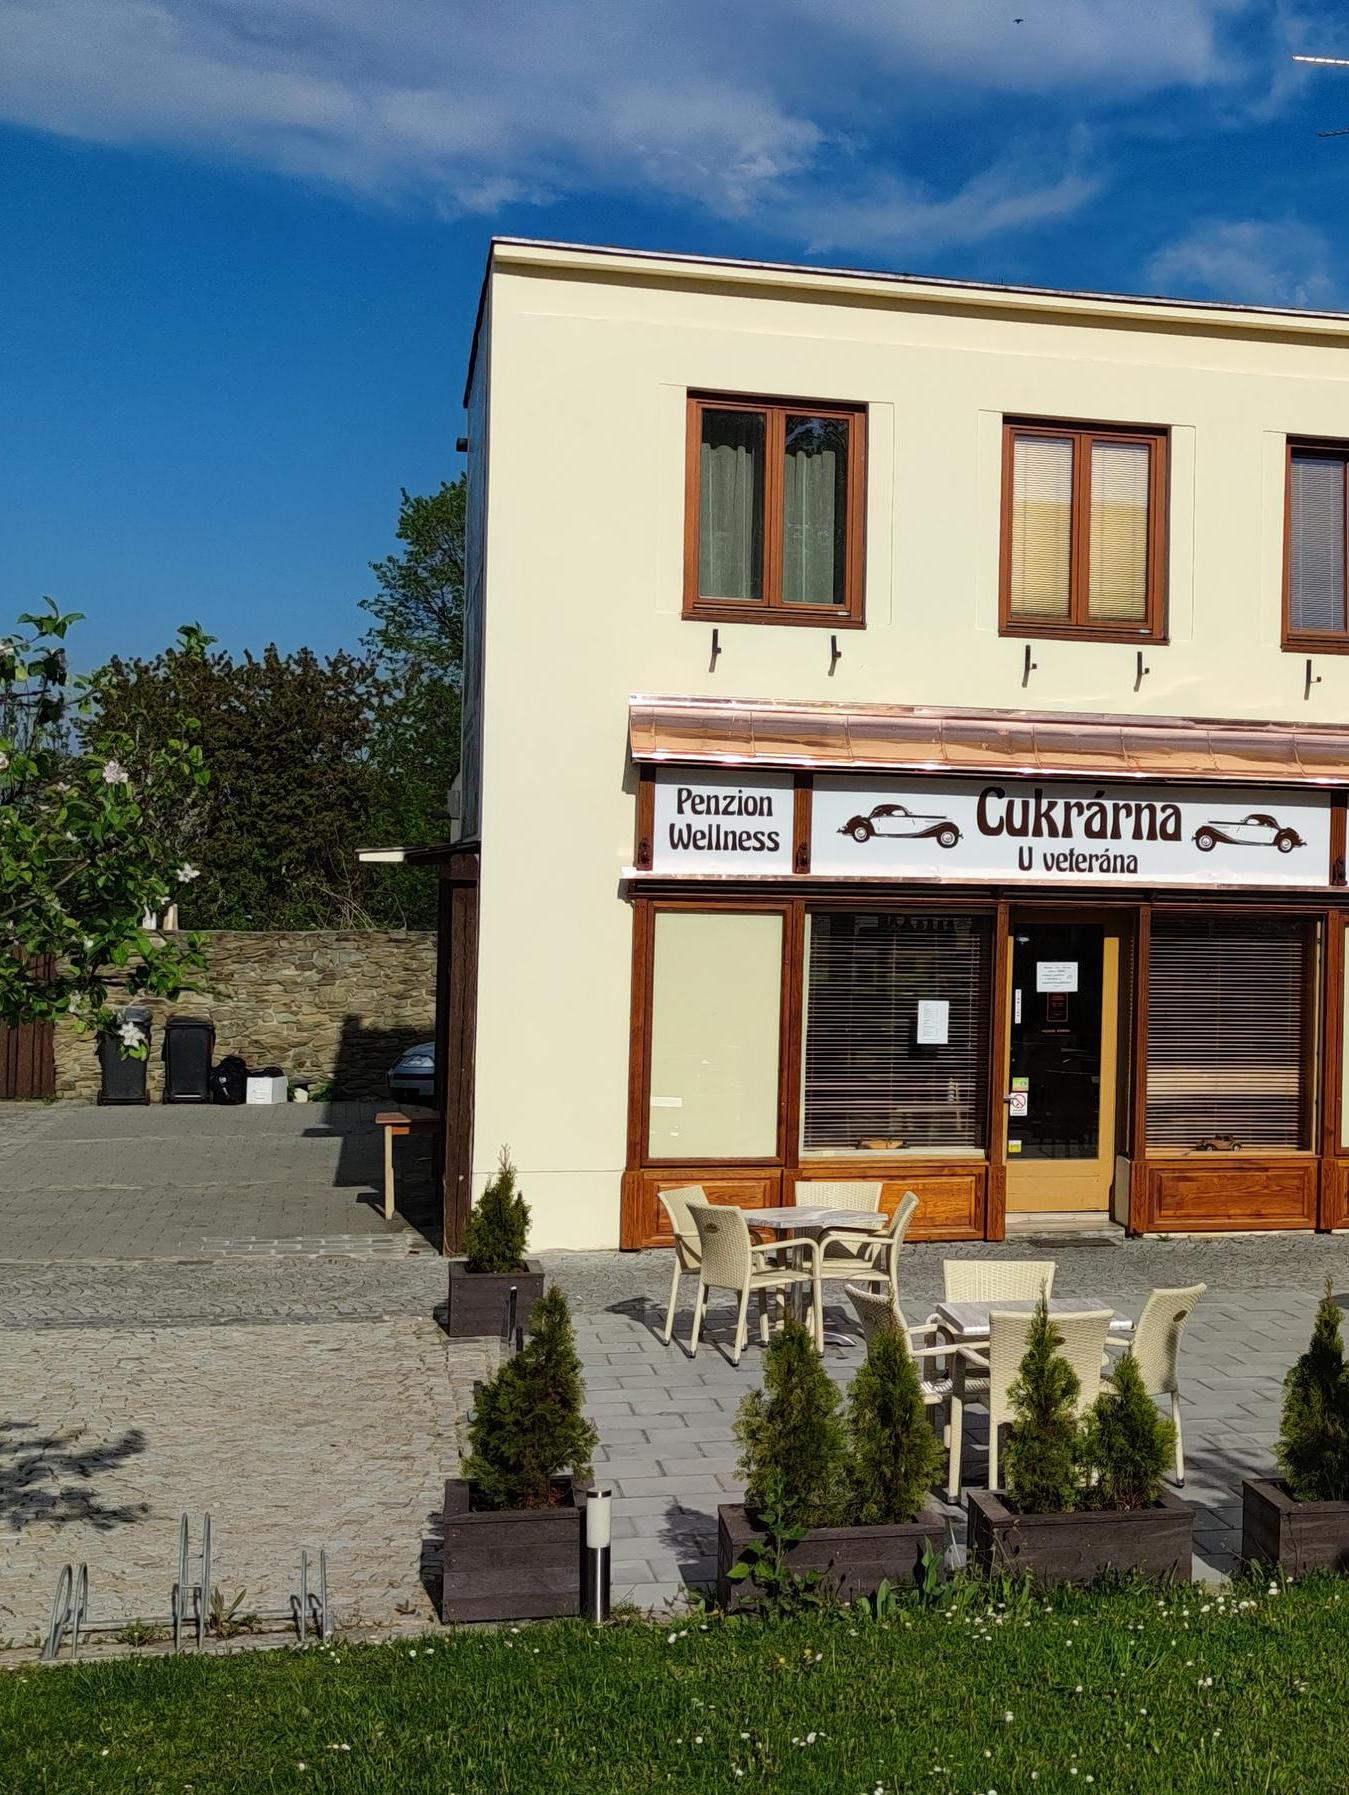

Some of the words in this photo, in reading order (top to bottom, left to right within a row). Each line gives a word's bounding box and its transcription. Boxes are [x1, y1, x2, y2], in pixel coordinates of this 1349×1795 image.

[676, 787, 774, 817] Penzion
[975, 786, 1182, 842] Cukrárna
[669, 823, 781, 852] Wellness
[1018, 846, 1034, 871] U
[1043, 847, 1139, 874] veterána
